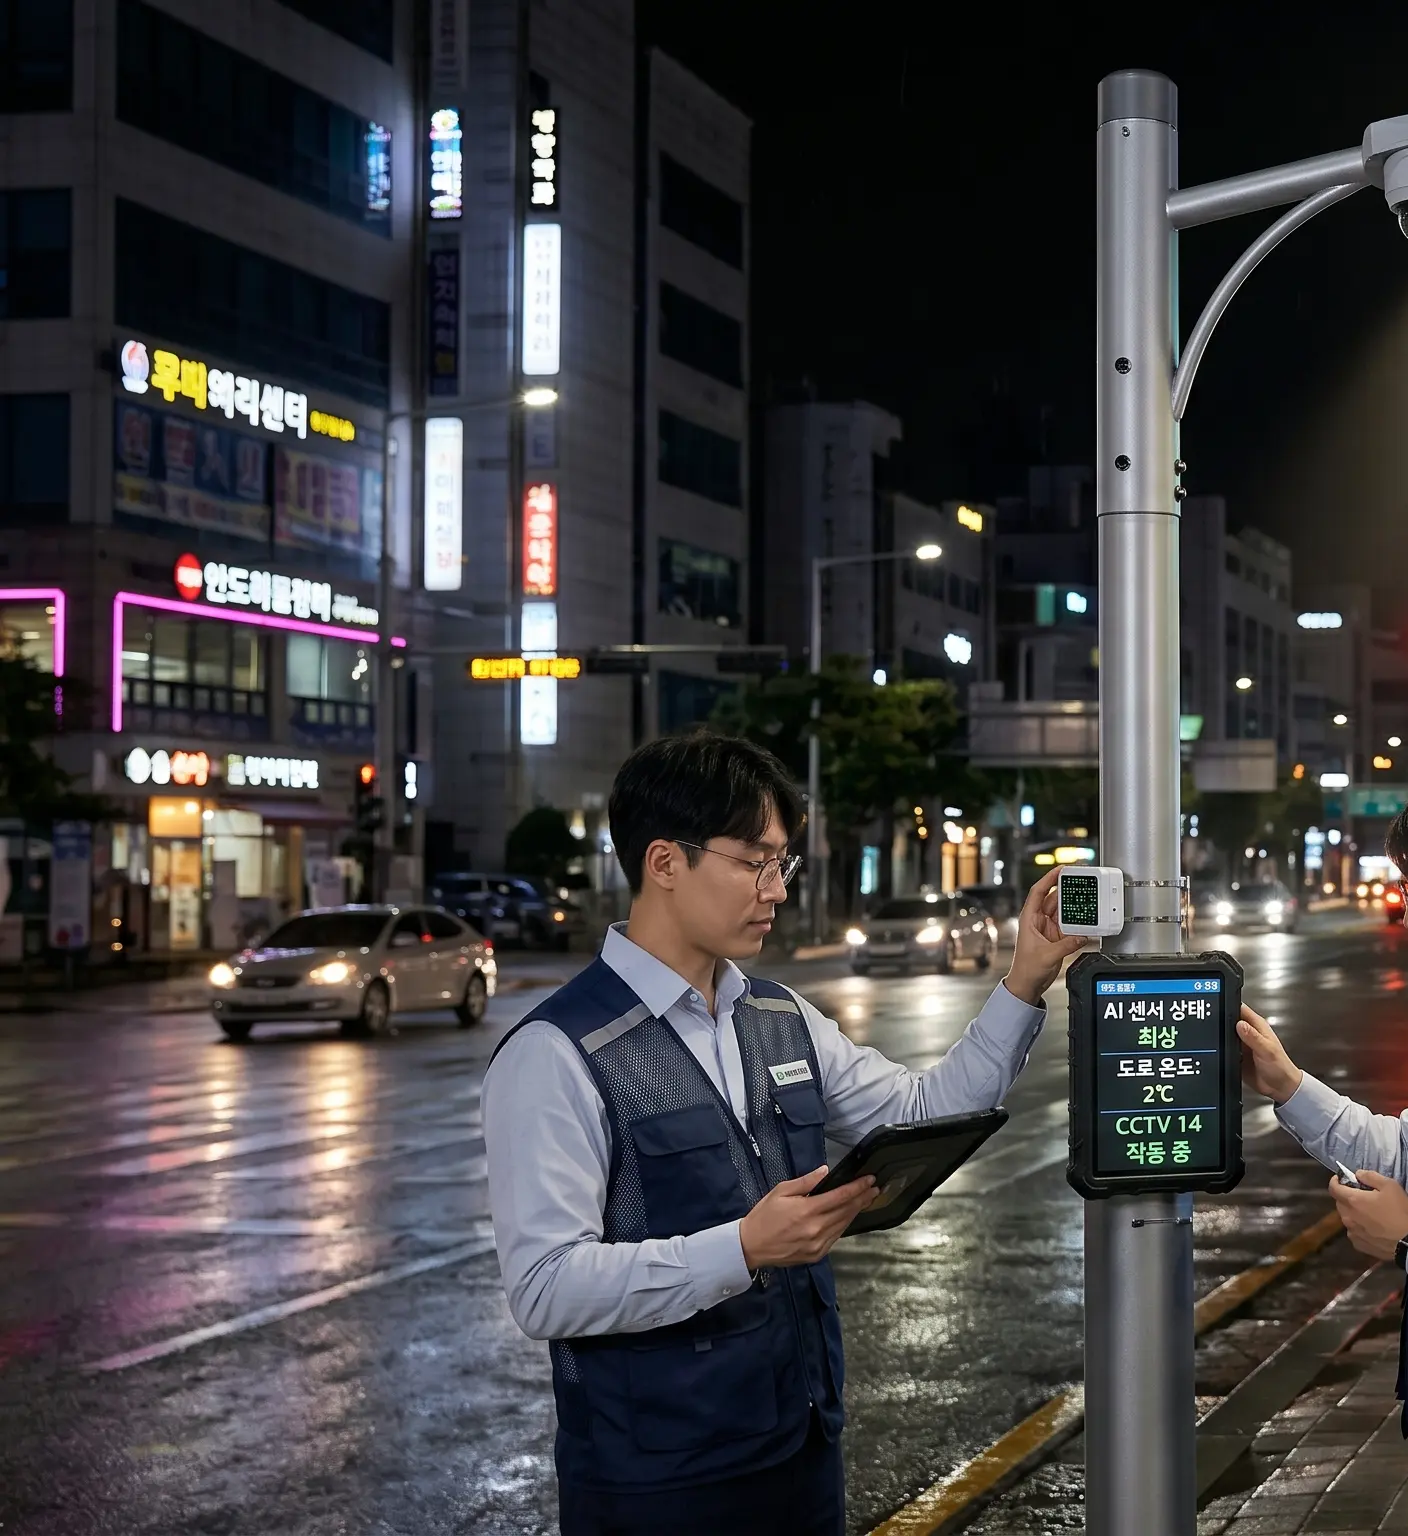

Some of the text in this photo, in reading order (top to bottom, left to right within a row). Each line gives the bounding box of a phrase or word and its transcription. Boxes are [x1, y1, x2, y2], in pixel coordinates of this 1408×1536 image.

[1104, 1000, 1210, 1021] AI 센서 상태:
[1138, 1026, 1178, 1048] 최상
[1117, 1058, 1200, 1077] 도로 온도:
[1116, 1115, 1202, 1134] CCTV 14
[1127, 1141, 1191, 1164] 작동 중
